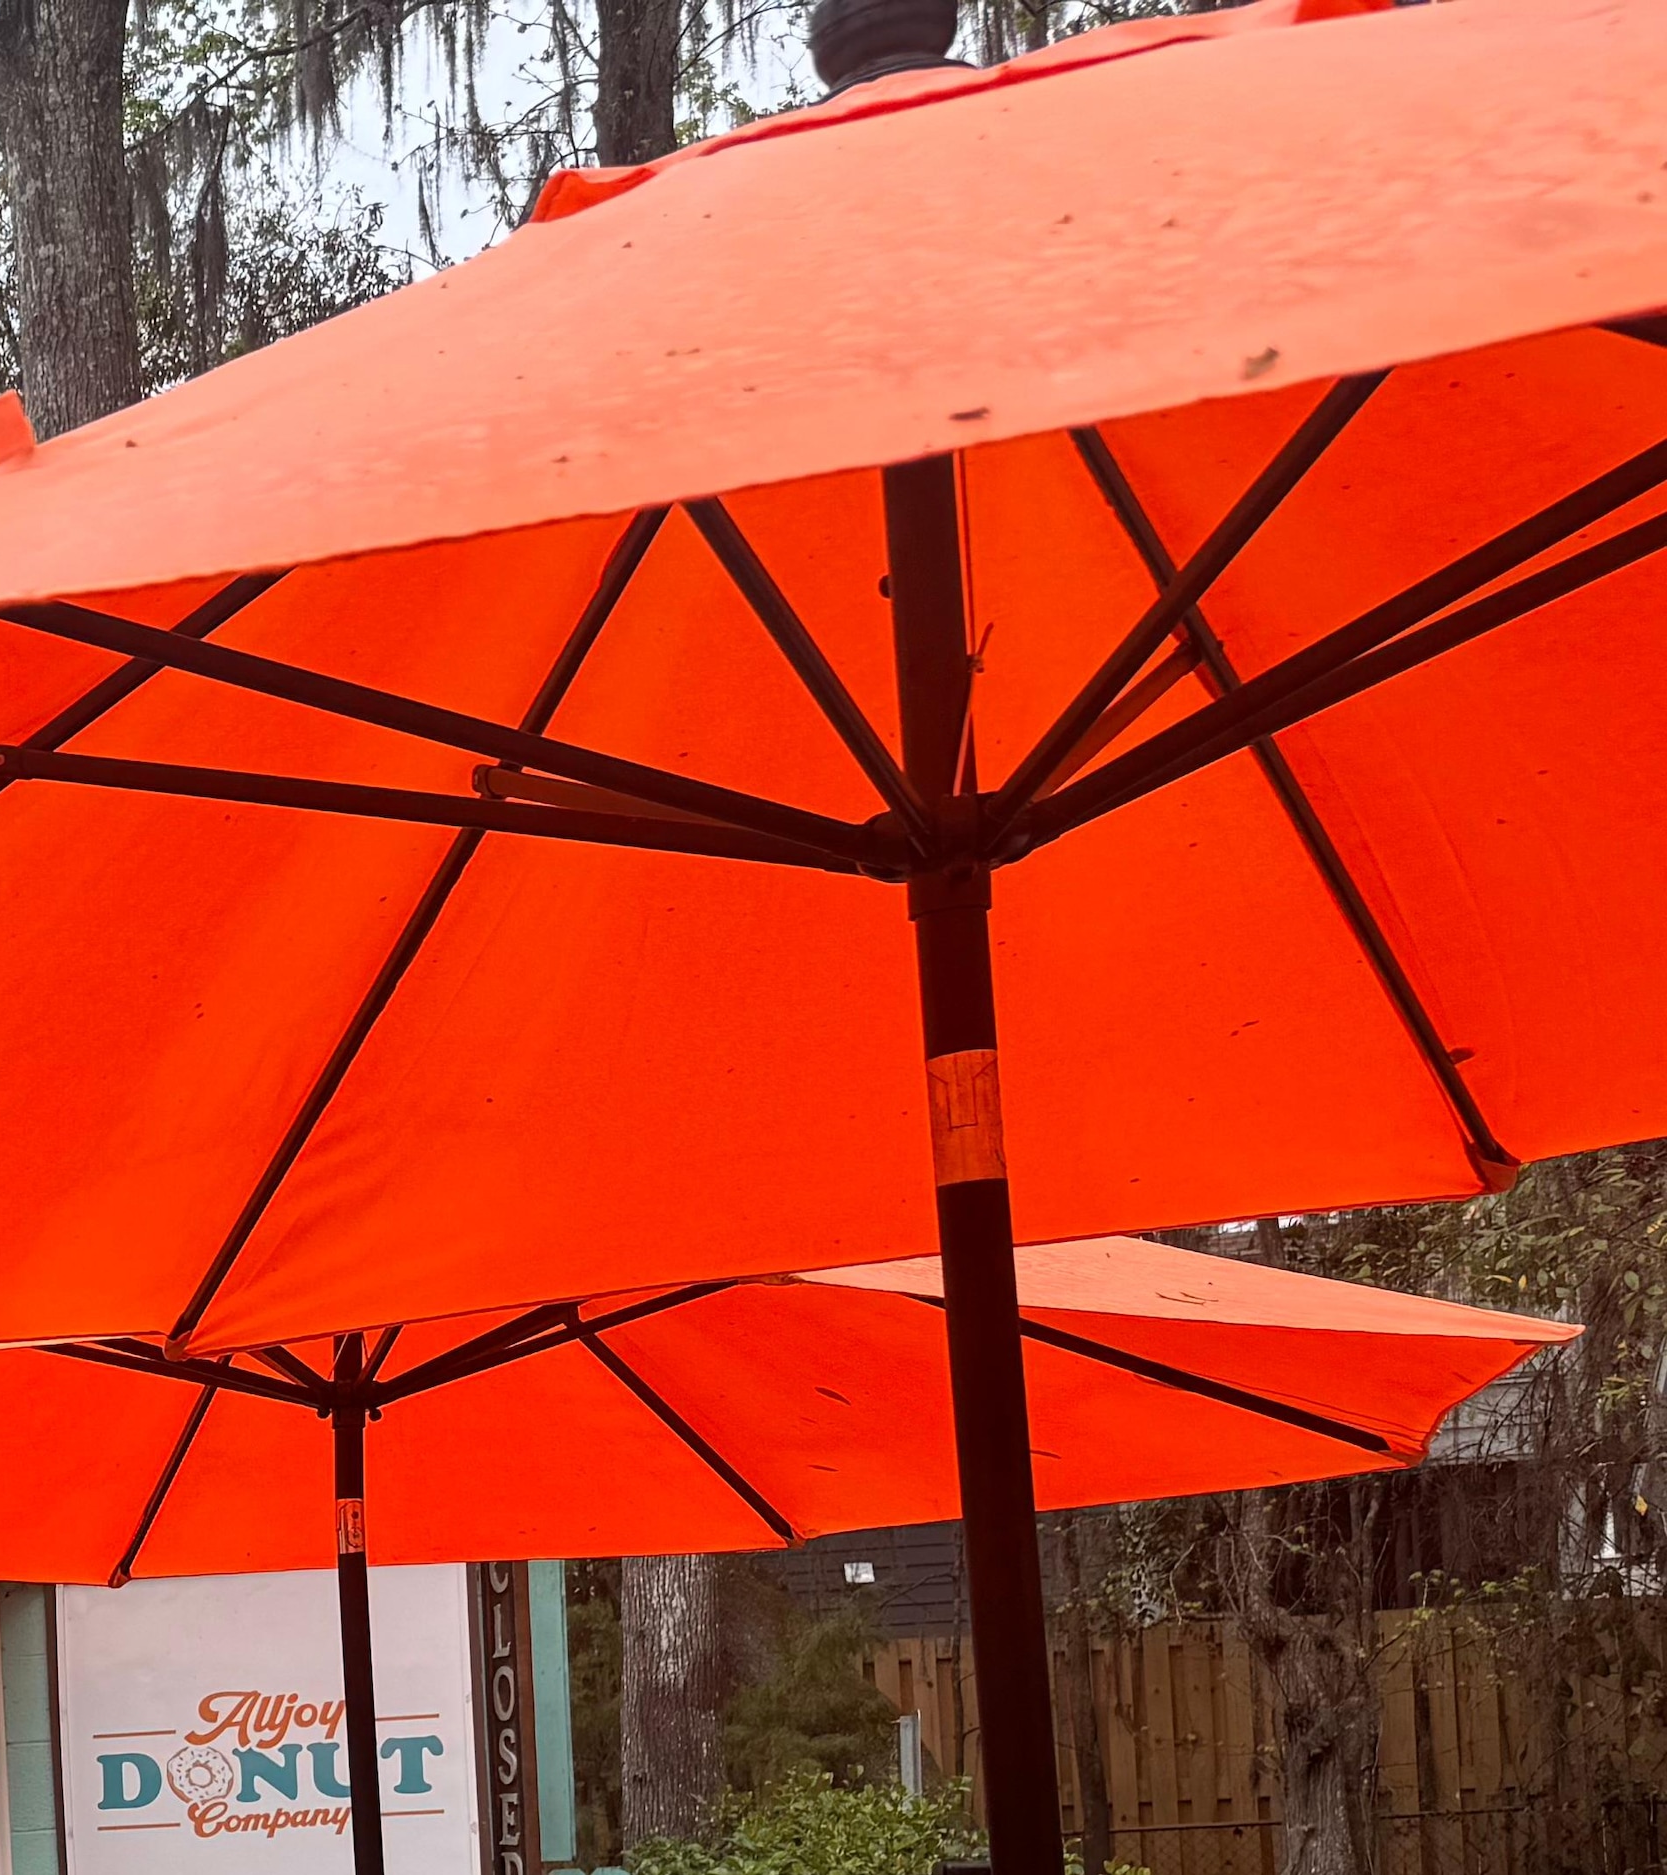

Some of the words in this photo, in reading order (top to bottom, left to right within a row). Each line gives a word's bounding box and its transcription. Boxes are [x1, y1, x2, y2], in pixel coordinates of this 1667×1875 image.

[184, 1690, 346, 1749] Alljoy
[96, 1735, 444, 1810] DONUT
[187, 1802, 351, 1839] Company
